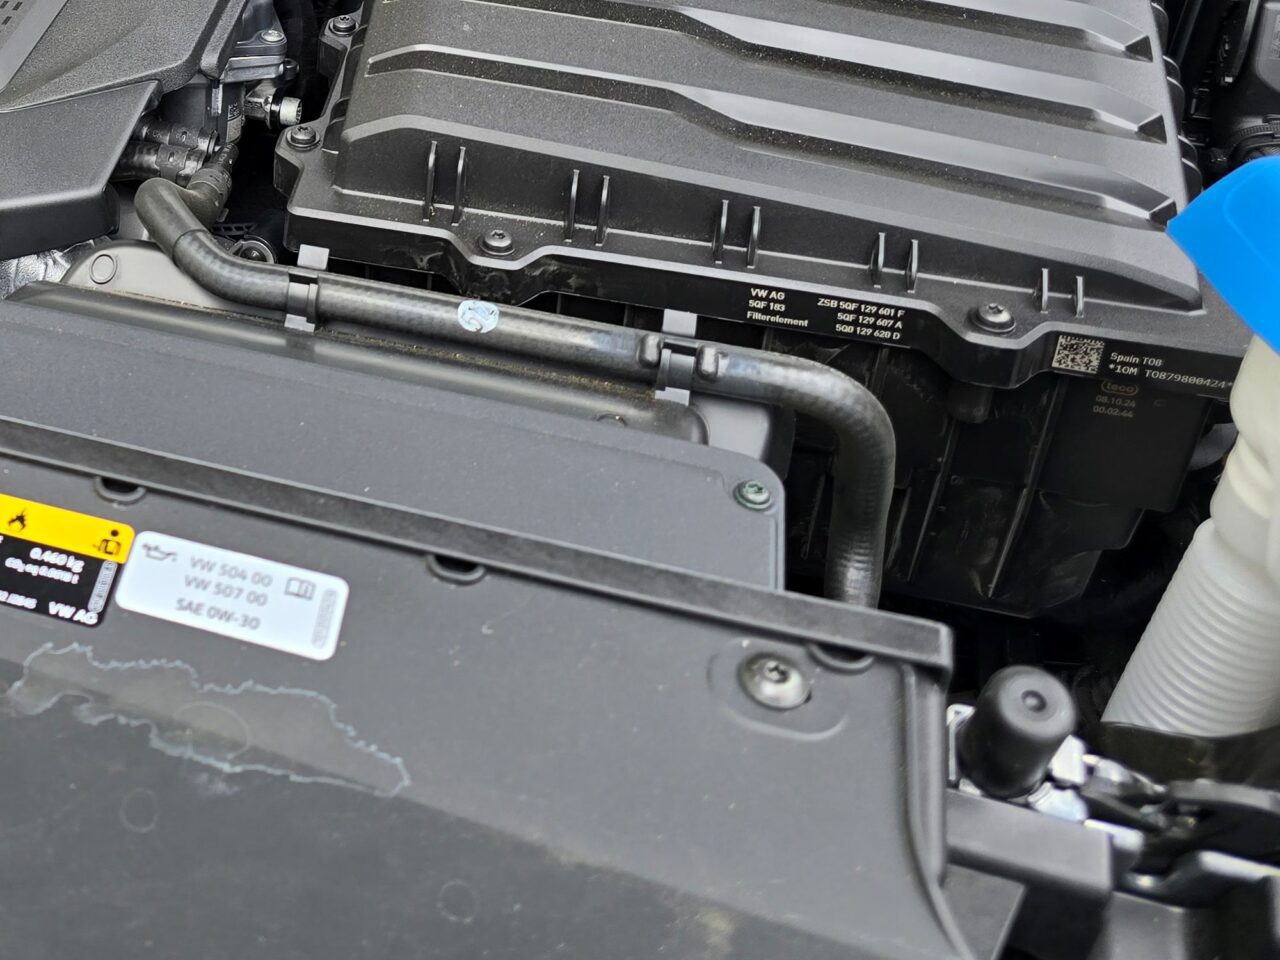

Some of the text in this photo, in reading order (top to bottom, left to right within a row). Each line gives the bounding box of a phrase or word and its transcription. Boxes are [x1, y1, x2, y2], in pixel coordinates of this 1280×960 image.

[750, 288, 786, 301] VW AG
[769, 302, 786, 312] 183
[817, 297, 838, 309] ZSB
[860, 304, 878, 314] 129
[878, 307, 896, 316] 601
[897, 310, 905, 318] F
[746, 311, 808, 328] Filterelement
[858, 315, 874, 325] 129
[876, 318, 894, 328] 607
[894, 320, 903, 329] A
[856, 326, 873, 336] 129
[873, 329, 891, 339] 620
[892, 331, 901, 340] D
[1110, 352, 1140, 365] Spain
[66, 555, 85, 573] kg
[189, 556, 273, 588] VW 504 00
[183, 574, 269, 607] VW 507 00
[48, 601, 98, 625] VW AG
[176, 597, 262, 631] SAE 0W-30
